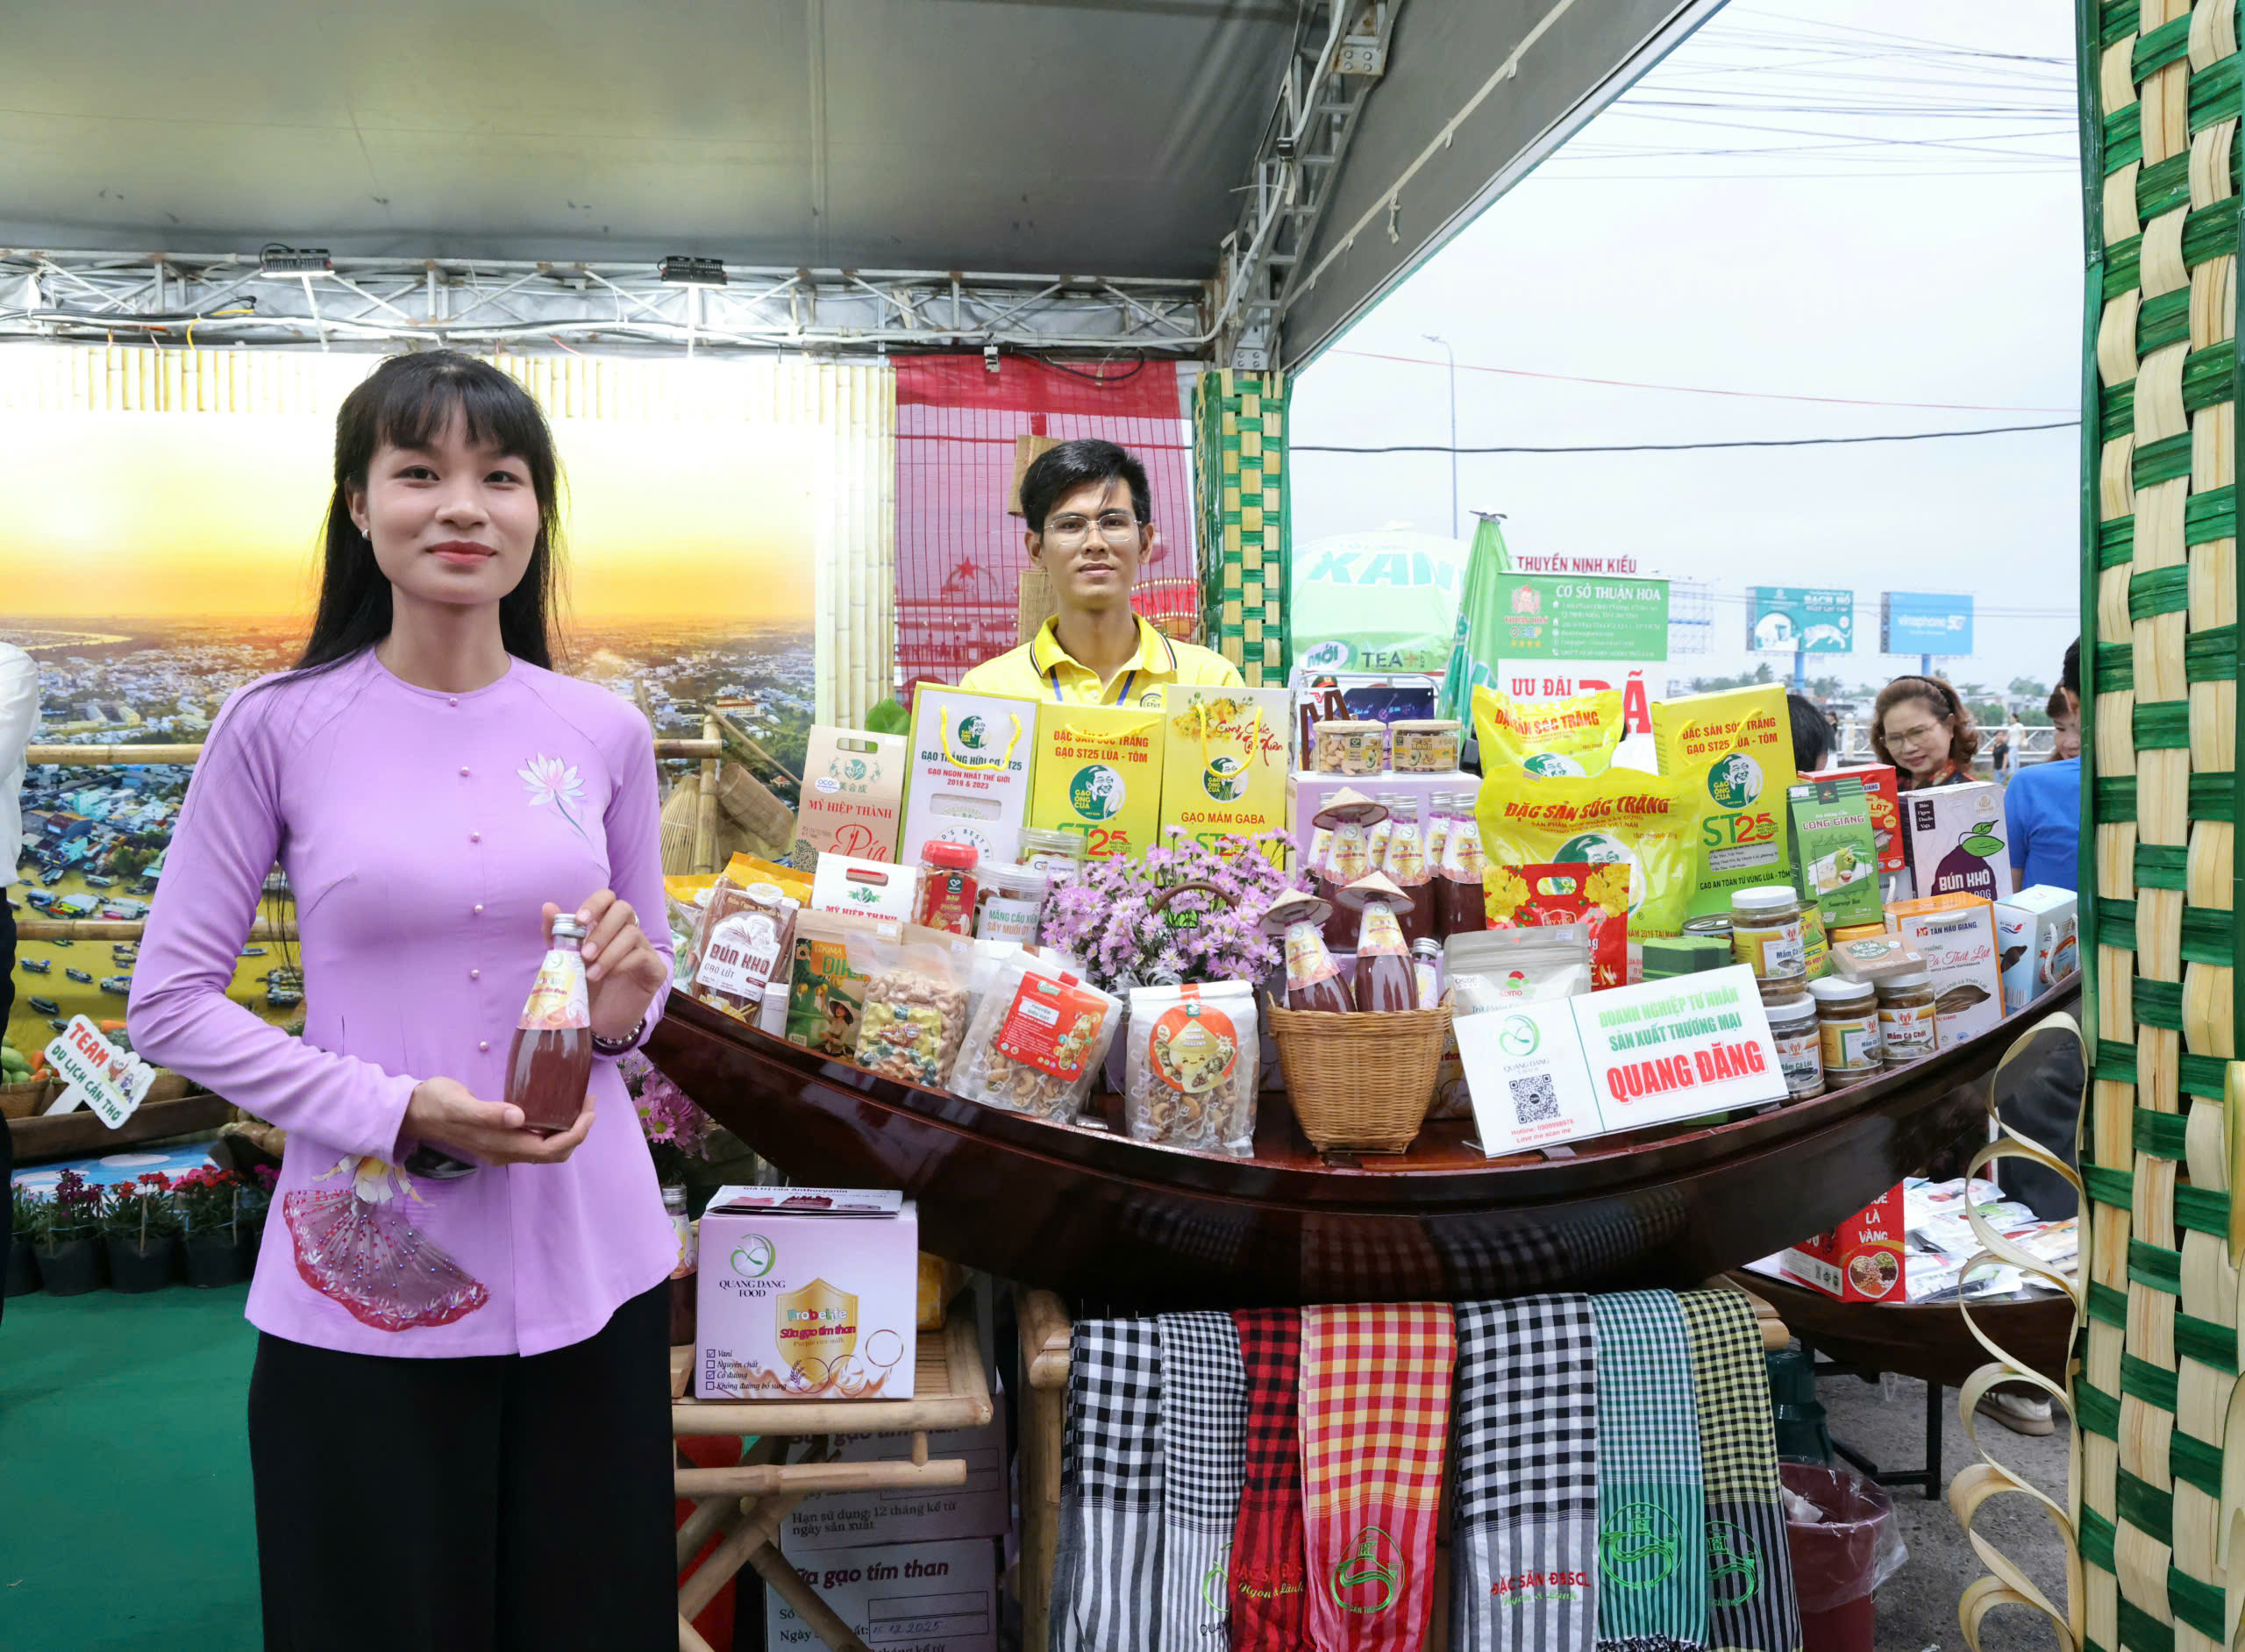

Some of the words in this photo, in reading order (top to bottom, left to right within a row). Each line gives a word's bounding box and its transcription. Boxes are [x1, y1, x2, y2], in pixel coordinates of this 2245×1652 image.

[1707, 737, 1729, 751] ST25
[1076, 748, 1099, 759] ST25
[1235, 814, 1265, 824] GABA
[1957, 922, 1977, 931] GIANG
[1608, 1029, 1635, 1051] SẢN
[1635, 1022, 1667, 1047] XUẤT
[1667, 1016, 1718, 1040] THƯƠNG
[1717, 1011, 1743, 1032] MẠI
[52, 1044, 68, 1061] DU
[64, 1058, 87, 1084] LỊCH
[1607, 1053, 1696, 1104] QUANG
[1693, 1040, 1767, 1084] ĐĂNG
[1865, 1209, 1880, 1224] LÀ
[719, 1280, 756, 1290] QUANG
[757, 1280, 786, 1289] DANG
[739, 1289, 766, 1298] FOOD
[793, 1513, 817, 1525] Hạn
[873, 1506, 887, 1517] 12
[890, 1504, 924, 1518] tháng
[793, 1526, 822, 1537] ngày
[825, 1522, 845, 1533] sản
[823, 1568, 862, 1589] gạo
[866, 1562, 898, 1581] tím
[904, 1559, 949, 1577] than
[780, 1630, 811, 1643] Ngày
